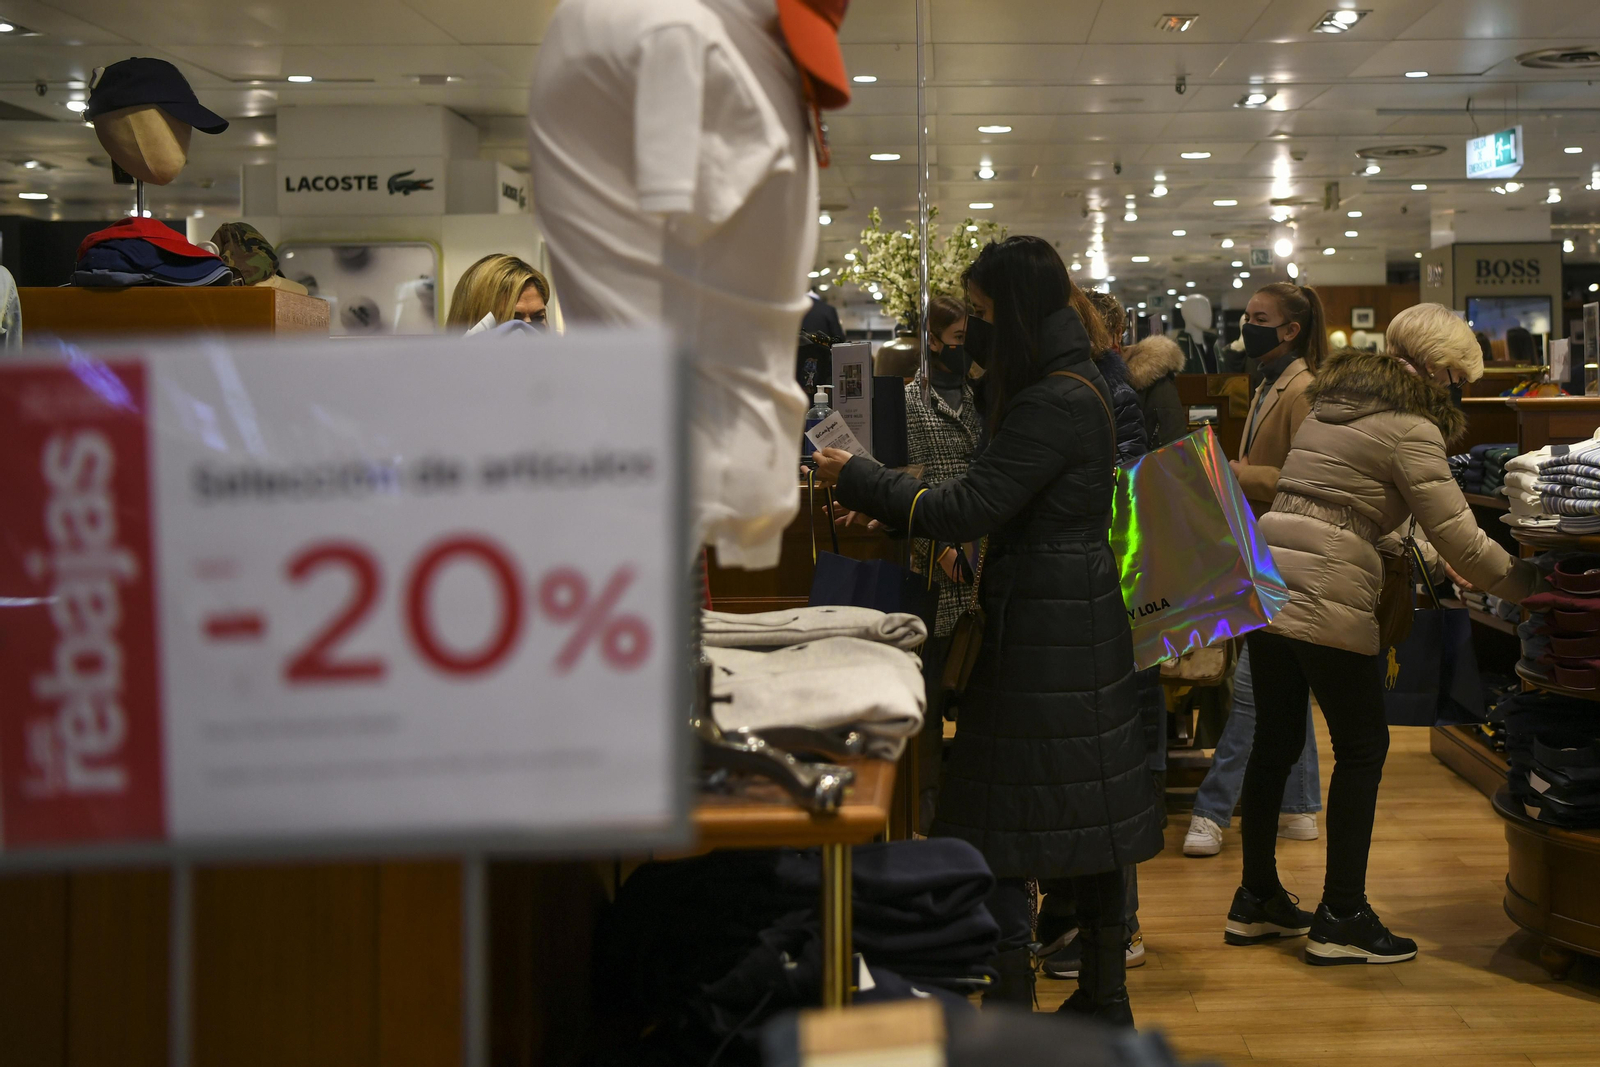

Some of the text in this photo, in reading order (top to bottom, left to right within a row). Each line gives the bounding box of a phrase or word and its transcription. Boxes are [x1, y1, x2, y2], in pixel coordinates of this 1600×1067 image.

[285, 175, 378, 192] LACOSTE
[1476, 259, 1540, 279] BOSS
[24, 430, 139, 793] rebajas
[1127, 598, 1170, 620] Y LOLA
